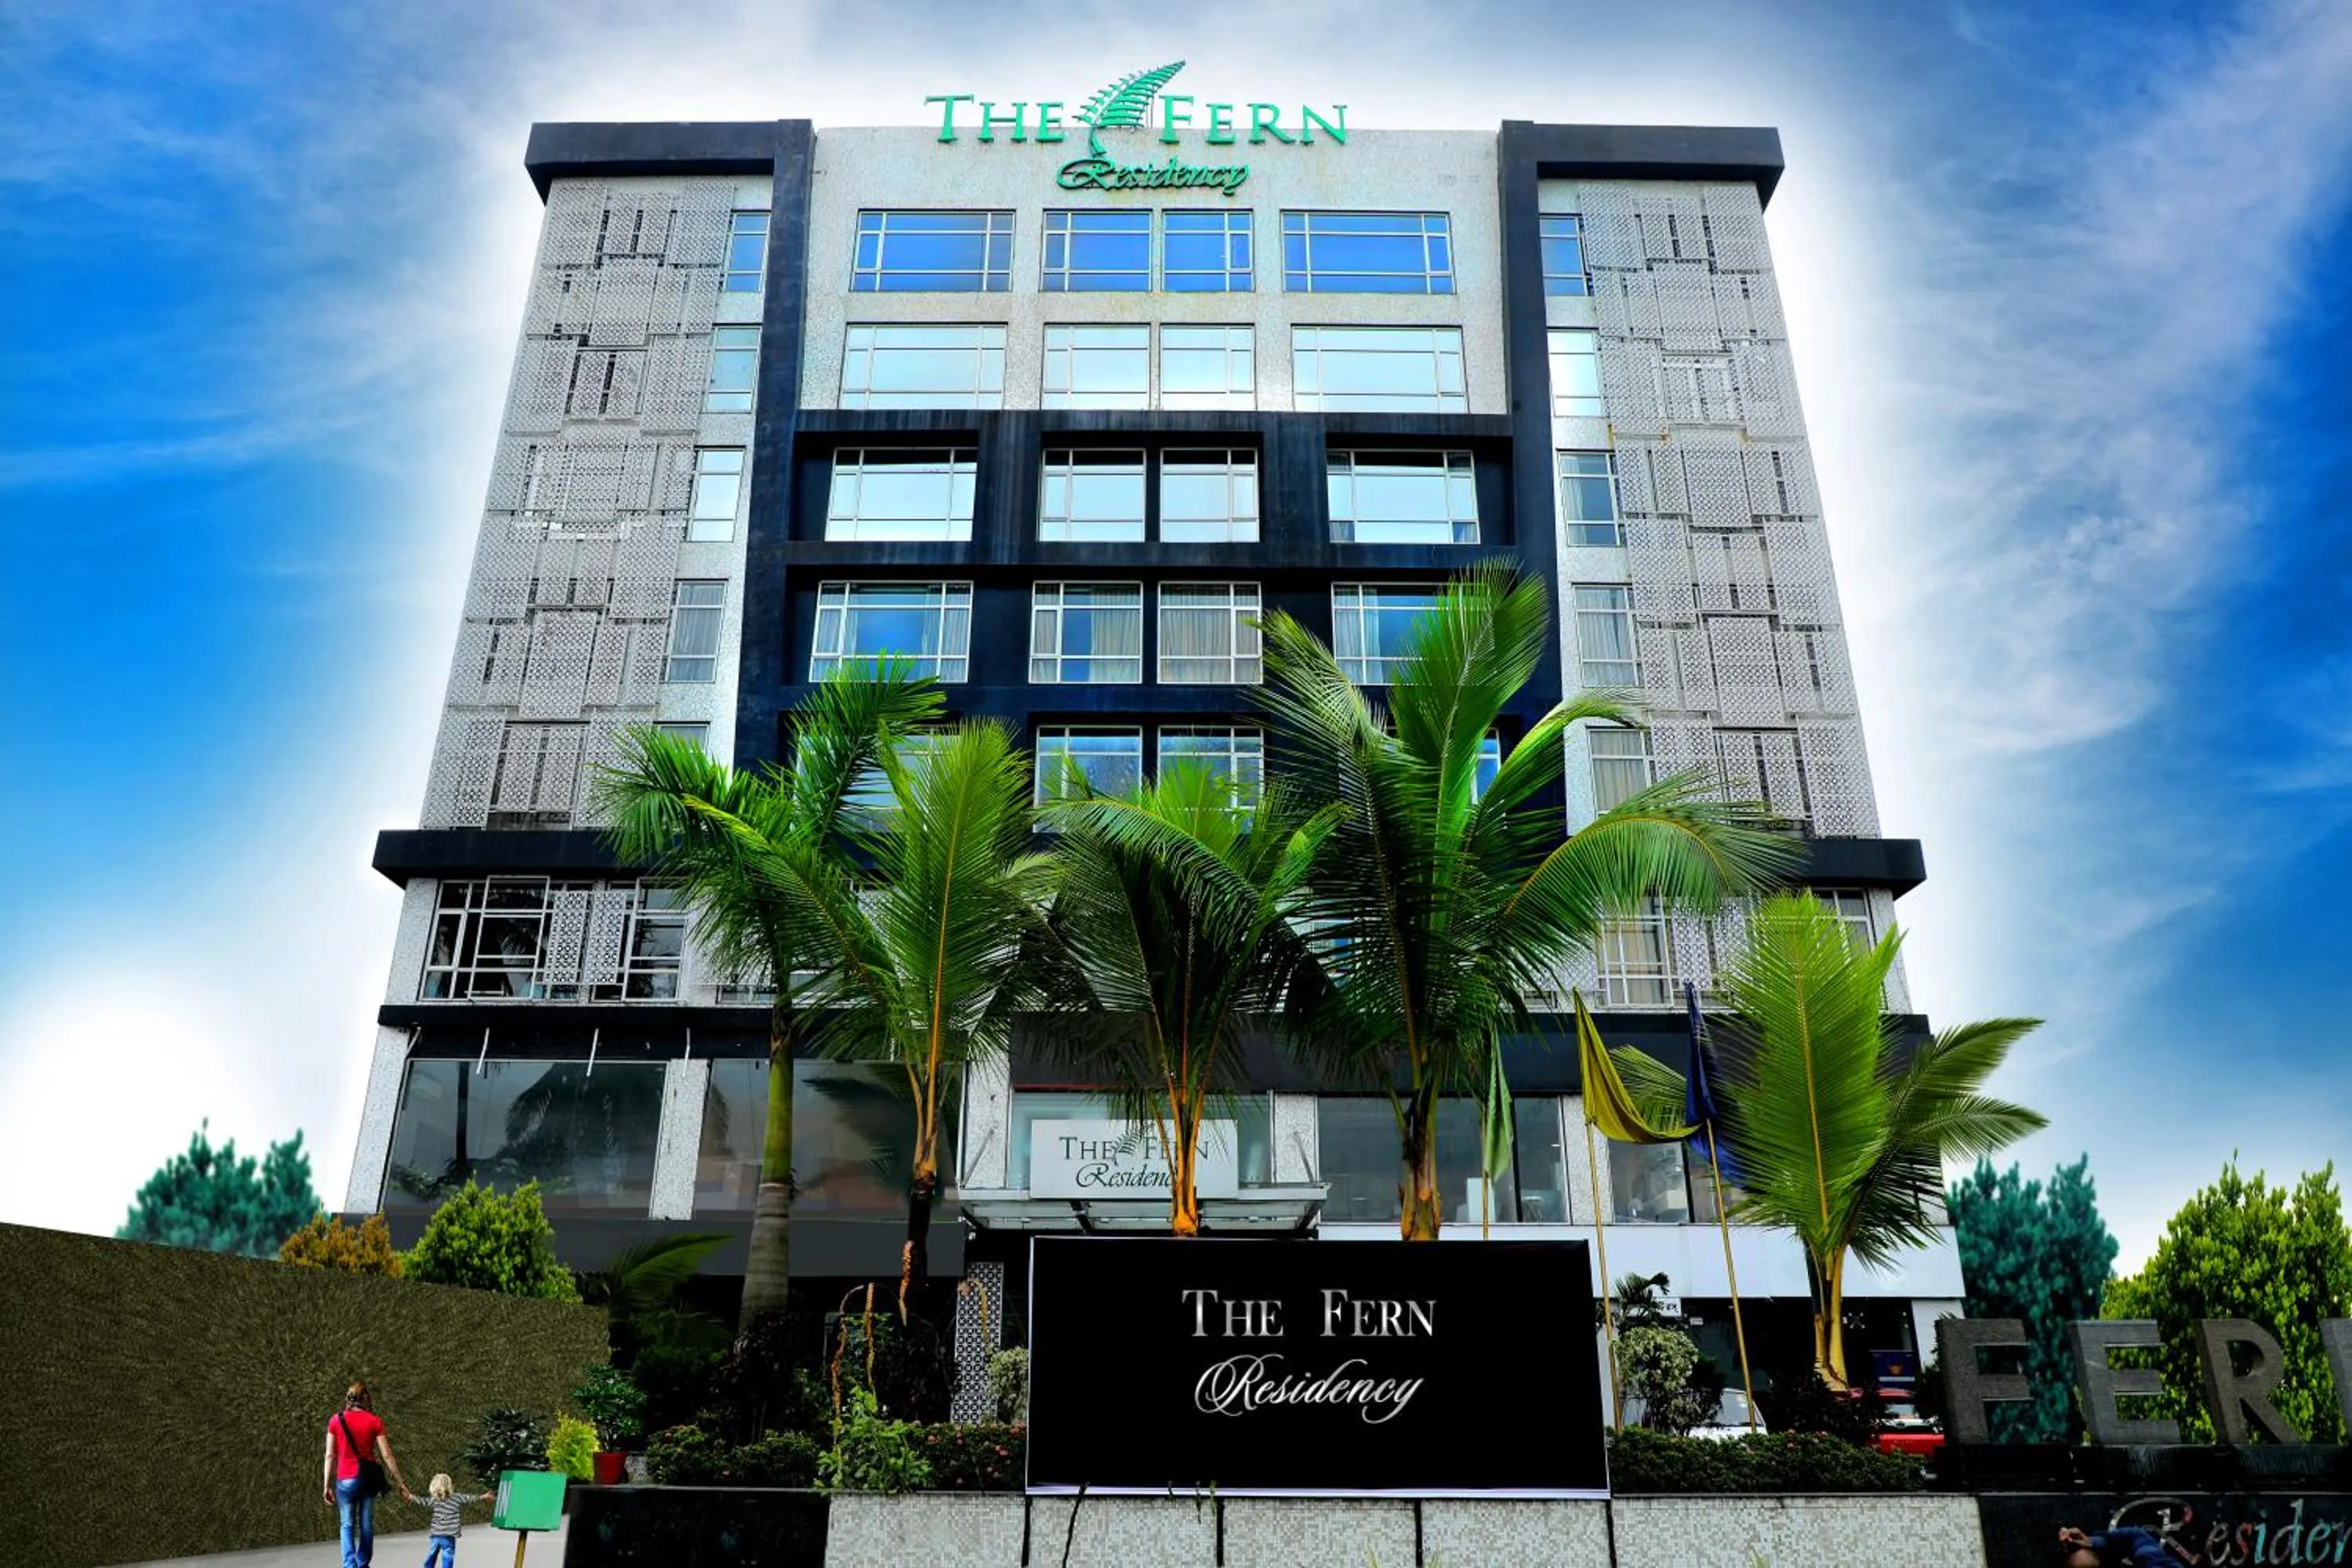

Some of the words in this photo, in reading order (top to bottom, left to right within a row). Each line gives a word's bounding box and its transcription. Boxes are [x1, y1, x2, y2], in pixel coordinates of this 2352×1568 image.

[924, 94, 1065, 143] THE
[1158, 94, 1348, 146] FERN
[1056, 155, 1250, 196] Residency
[1059, 1137, 1116, 1160] THE
[1181, 1290, 1284, 1337] THE
[1319, 1288, 1438, 1337] FERN
[1194, 1353, 1425, 1425] Residency
[1935, 1317, 2352, 1446] FER
